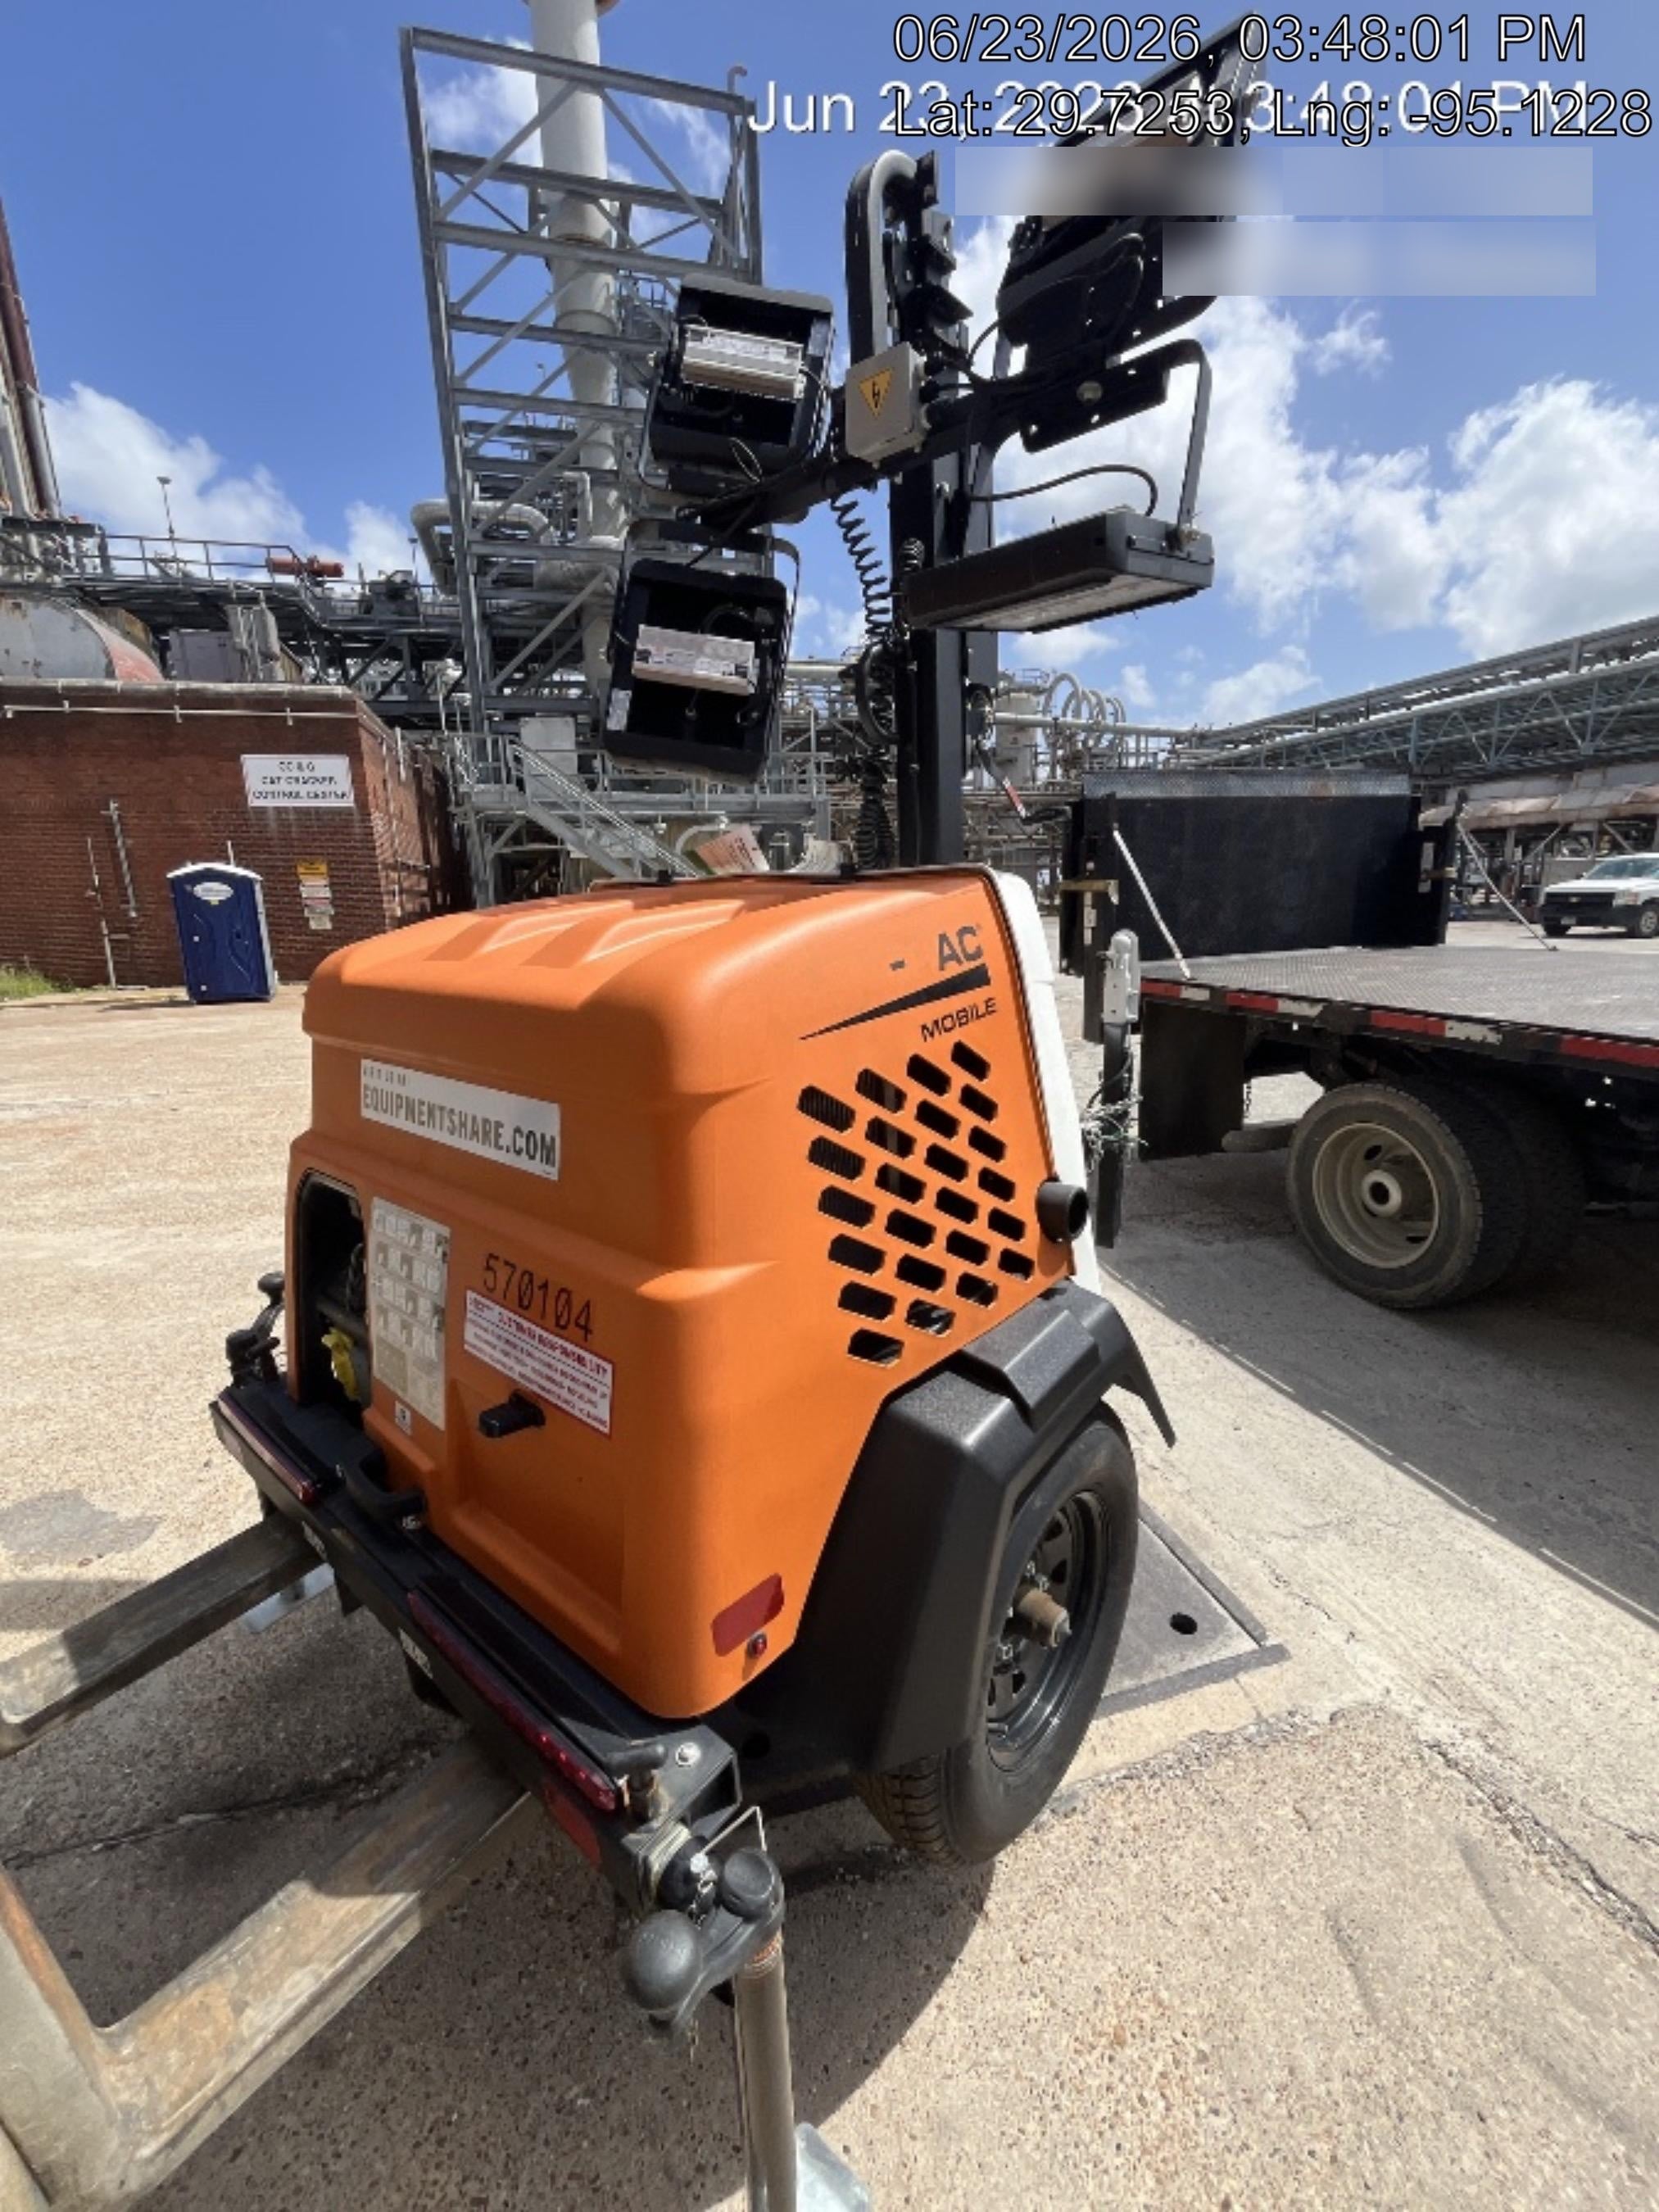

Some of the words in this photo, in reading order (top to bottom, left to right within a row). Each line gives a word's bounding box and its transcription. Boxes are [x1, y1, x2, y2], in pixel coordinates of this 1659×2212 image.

[938, 926, 983, 971] AC
[921, 997, 997, 1042] MOBILE
[483, 1253, 593, 1343] 570104
